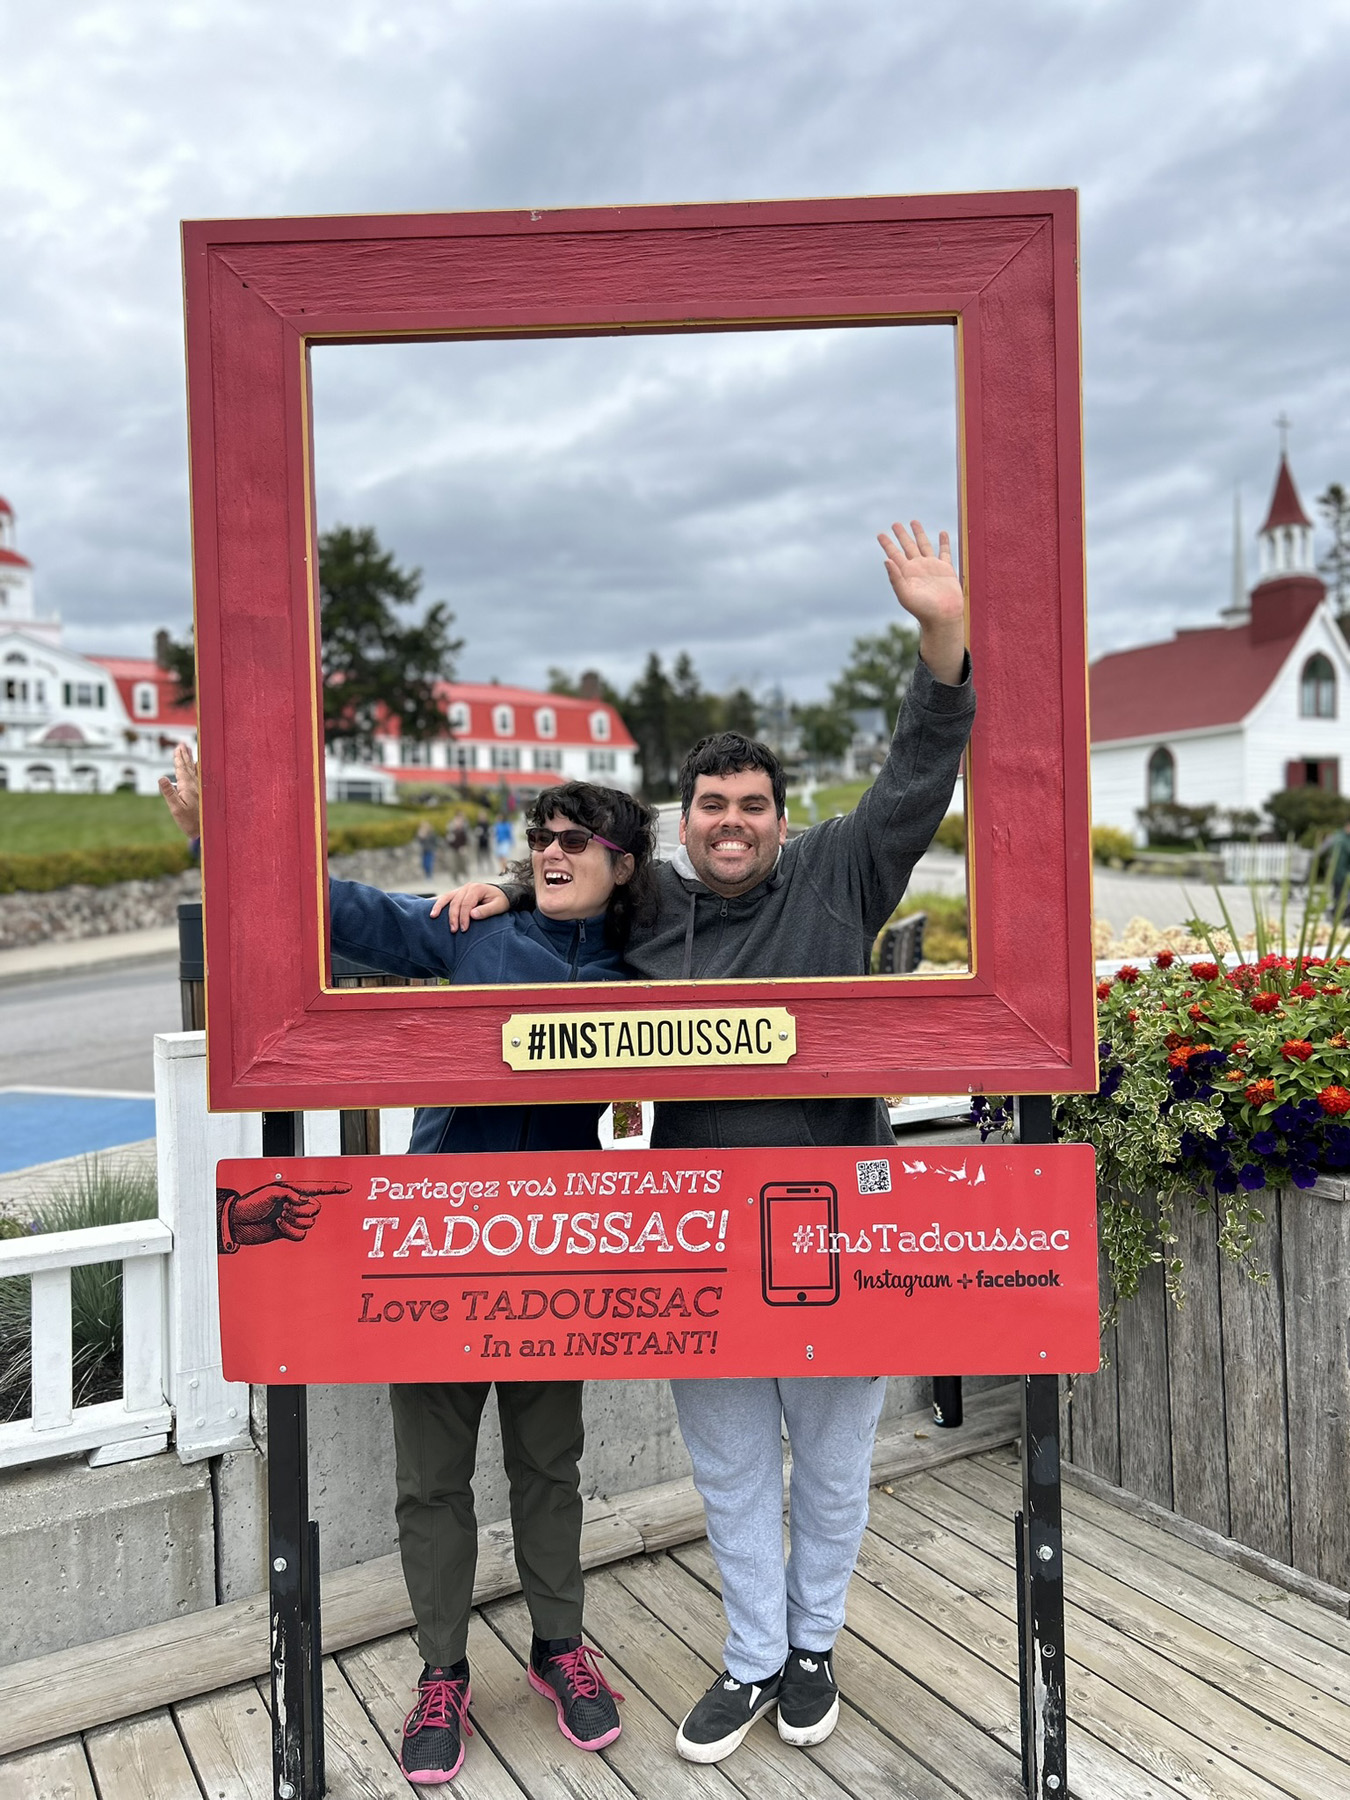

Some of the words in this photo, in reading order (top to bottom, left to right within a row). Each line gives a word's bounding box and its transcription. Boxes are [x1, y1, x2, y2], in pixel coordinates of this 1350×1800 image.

[528, 1018, 772, 1060] #INSTADOUSSAC
[367, 1177, 500, 1208] Partagez
[508, 1178, 557, 1198] vos
[563, 1170, 723, 1196] INSTANTS
[362, 1209, 730, 1259] TADOUSSAC!
[791, 1222, 1071, 1254] #InsTadoussac
[853, 1268, 953, 1298] Instagram
[975, 1268, 1060, 1288] facebook
[357, 1293, 450, 1323] Love
[460, 1287, 722, 1321] TADOUSSAC
[480, 1334, 511, 1358] In
[518, 1339, 557, 1357] an
[563, 1330, 718, 1357] INSTANT!
